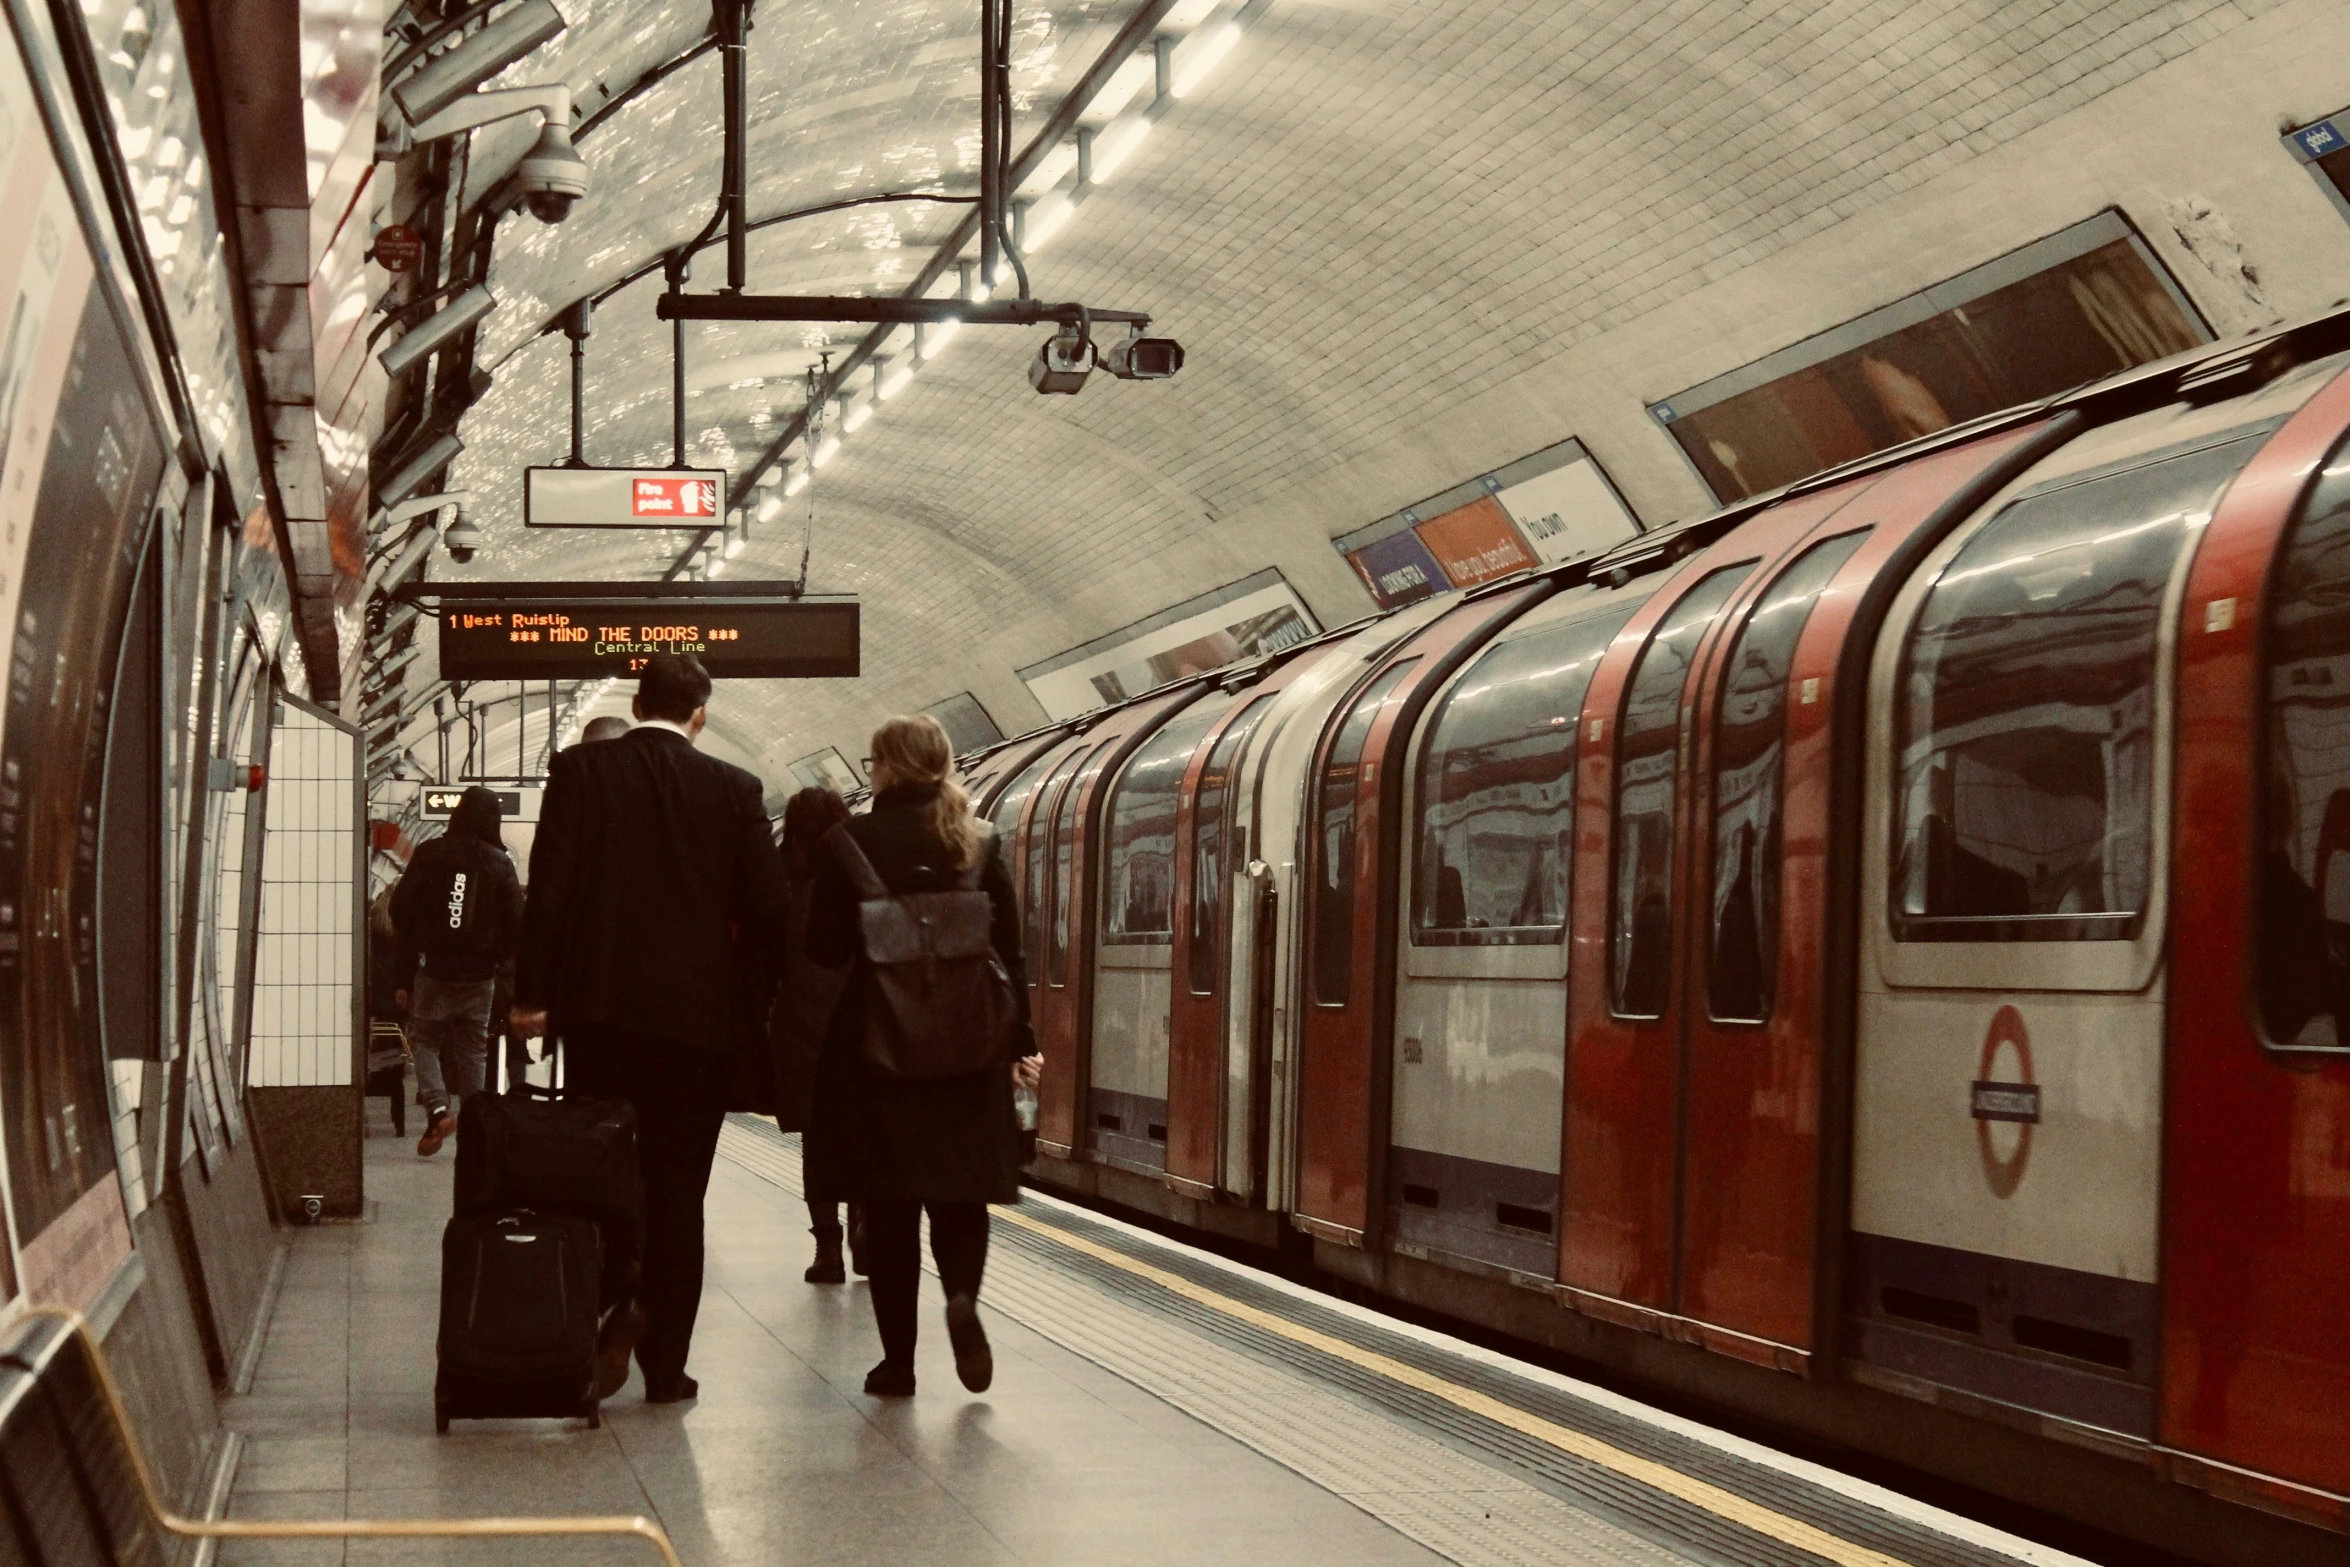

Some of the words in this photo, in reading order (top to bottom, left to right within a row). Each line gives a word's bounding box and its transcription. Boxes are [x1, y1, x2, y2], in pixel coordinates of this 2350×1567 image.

[638, 482, 663, 495] Fire
[638, 497, 673, 512] point
[1519, 515, 1549, 541] You
[1541, 512, 1568, 535] own
[1446, 557, 1474, 580] love
[1379, 569, 1411, 595] LOOKING
[1401, 565, 1423, 587] FOR
[1413, 563, 1429, 582] A
[449, 614, 457, 629] 1
[463, 614, 502, 629] West
[512, 613, 570, 628] Ruislip
[550, 627, 589, 641] MIND
[599, 627, 631, 641] THE
[641, 627, 699, 641] DOORS
[594, 641, 660, 656] Central
[670, 641, 706, 654] Line
[448, 873, 467, 929] adidas
